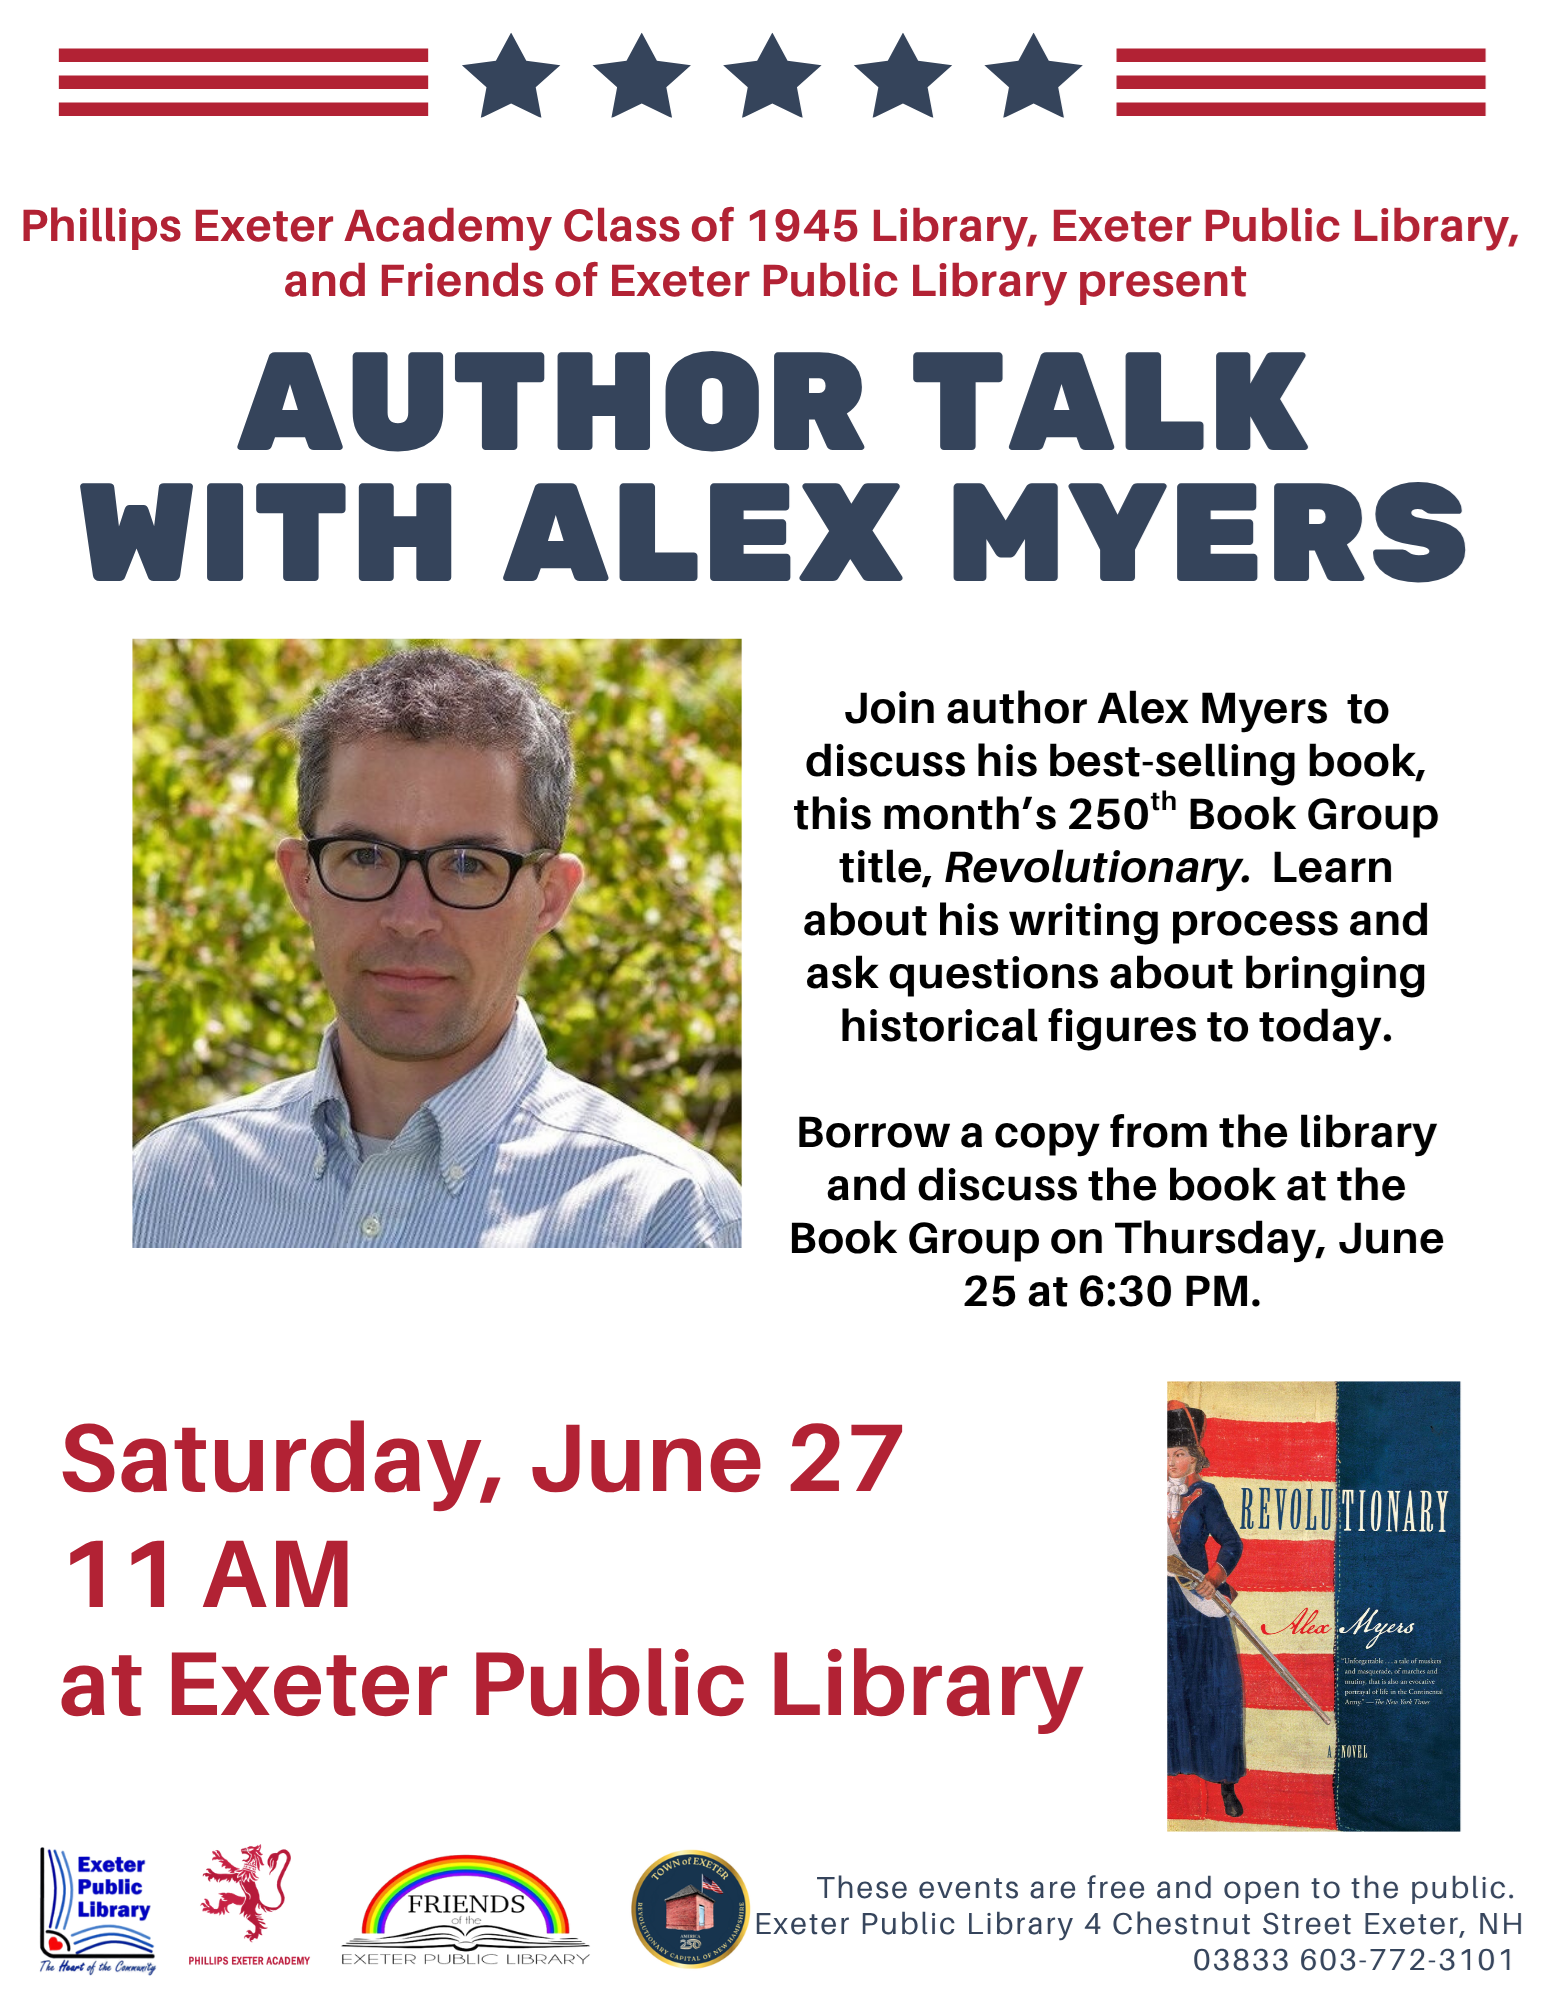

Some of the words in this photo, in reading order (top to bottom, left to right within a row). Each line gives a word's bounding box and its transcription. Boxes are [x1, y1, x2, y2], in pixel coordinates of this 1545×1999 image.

[22, 206, 182, 251] Phillips
[195, 209, 334, 243] Exeter
[343, 207, 553, 252] Academy
[563, 207, 681, 243] Class
[691, 206, 735, 243] of
[749, 208, 858, 243] 1945
[873, 207, 1038, 252] Library,
[1053, 209, 1192, 243] Exeter
[1205, 207, 1340, 243] Public
[1354, 207, 1519, 252] Library,
[284, 262, 366, 298] and
[381, 262, 544, 298] Friends
[554, 261, 599, 298] of
[611, 264, 751, 298] Exeter
[763, 262, 898, 298] Public
[912, 262, 1068, 307] Library
[1079, 265, 1247, 306] present
[236, 350, 865, 453] AUTHOR
[912, 351, 1309, 451] TALK
[79, 482, 452, 582] WITH
[502, 482, 904, 582] ALEX
[953, 481, 1466, 584] MYERS
[844, 690, 935, 725] Join
[946, 689, 1088, 725] author
[1097, 690, 1189, 725] Alex
[1201, 692, 1328, 733] Myers
[1346, 693, 1390, 725] to
[805, 743, 966, 778] discuss
[977, 742, 1038, 778] his
[1049, 743, 1296, 787] best-selling
[1309, 743, 1426, 782] book,
[793, 795, 872, 831] this
[883, 795, 1057, 831] month’s
[1190, 796, 1297, 831] Book
[1307, 797, 1439, 839] Group
[838, 849, 932, 888] title,
[944, 849, 1250, 892] Revolutionary.
[1274, 851, 1392, 884] Learn
[803, 902, 928, 937] about
[939, 901, 999, 937] his
[1008, 902, 1159, 946] writing
[1172, 910, 1339, 945] process
[1349, 902, 1428, 937] and
[806, 955, 880, 990] ask
[889, 955, 1099, 998] questions
[1109, 955, 1234, 990] about
[1245, 955, 1425, 999] bringing
[841, 1007, 1038, 1043] historical
[1047, 1007, 1197, 1052] figures
[1206, 1011, 1249, 1043] to
[1258, 1008, 1392, 1051] today.
[798, 1116, 951, 1149] Borrow
[960, 1122, 983, 1149] a
[994, 1122, 1100, 1157] copy
[1109, 1113, 1208, 1149] from
[1218, 1113, 1288, 1149] the
[1300, 1114, 1438, 1157] library
[827, 1167, 906, 1202] and
[918, 1167, 1078, 1202] discuss
[1087, 1166, 1157, 1202] the
[1169, 1167, 1277, 1202] book
[1286, 1170, 1327, 1202] at
[1336, 1166, 1406, 1202] the
[791, 1220, 898, 1255] Book
[908, 1221, 1040, 1263] Group
[1050, 1228, 1103, 1255] on
[1114, 1219, 1326, 1263] Thursday,
[1338, 1222, 1444, 1255] June
[963, 1274, 1016, 1308] 25
[1028, 1276, 1068, 1308] at
[1079, 1274, 1172, 1308] 6:30
[1186, 1275, 1261, 1308] PM.
[62, 1419, 501, 1512] Saturday,
[531, 1424, 762, 1493] June
[790, 1422, 903, 1492] 27
[1239, 1487, 1449, 1533] REVOLUTIONARY
[69, 1540, 165, 1608] 11
[202, 1540, 349, 1608] AM
[1260, 1607, 1332, 1635] Alex
[1339, 1607, 1415, 1650] Myers
[60, 1654, 143, 1717] at
[171, 1651, 448, 1717] Exeter
[475, 1647, 745, 1717] Public
[773, 1647, 1084, 1735] Library
[1345, 1688, 1370, 1696] portrayal
[1327, 1744, 1332, 1758] A
[1341, 1744, 1368, 1759] NOVEL
[77, 1856, 146, 1873] Exeter
[651, 1858, 681, 1881] TOWN
[681, 1857, 692, 1866] of
[692, 1857, 729, 1881] EXETER
[77, 1878, 143, 1896] Public
[408, 1894, 525, 1913] FRIENDS
[816, 1874, 908, 1900] These
[918, 1877, 1019, 1900] events
[1030, 1880, 1076, 1900] are
[1087, 1874, 1145, 1900] free
[1156, 1875, 1212, 1900] and
[1223, 1880, 1299, 1905] open
[1311, 1877, 1341, 1900] to
[1351, 1874, 1399, 1900] the
[1411, 1875, 1514, 1905] public.
[77, 1900, 151, 1922] Library
[450, 1915, 463, 1925] of
[465, 1915, 482, 1925] the
[637, 1902, 669, 1955] REVOLUTIONARY
[669, 1952, 701, 1962] CAPITAL
[702, 1952, 712, 1960] OF
[713, 1943, 728, 1956] NEW
[727, 1902, 745, 1944] HAMPSHIRE
[756, 1912, 850, 1936] Exeter
[862, 1911, 955, 1936] Public
[968, 1911, 1074, 1941] Library
[1084, 1912, 1101, 1935] 4
[1112, 1910, 1251, 1936] Chestnut
[1262, 1912, 1352, 1936] Street
[1364, 1912, 1465, 1939] Exeter,
[1479, 1912, 1522, 1935] NH
[40, 1960, 55, 1972] The
[58, 1960, 84, 1971] Heart
[86, 1960, 96, 1975] of
[98, 1960, 112, 1972] the
[114, 1960, 156, 1976] Community
[188, 1956, 229, 1966] PHILLIPS
[231, 1956, 264, 1966] EXETER
[265, 1956, 311, 1966] ACADEMY
[341, 1953, 417, 1965] EXETER
[424, 1953, 498, 1965] PUBLIC
[506, 1953, 590, 1965] LIBRARY
[1193, 1948, 1289, 1972] 03833
[1300, 1948, 1510, 1972] 603-772-3101
